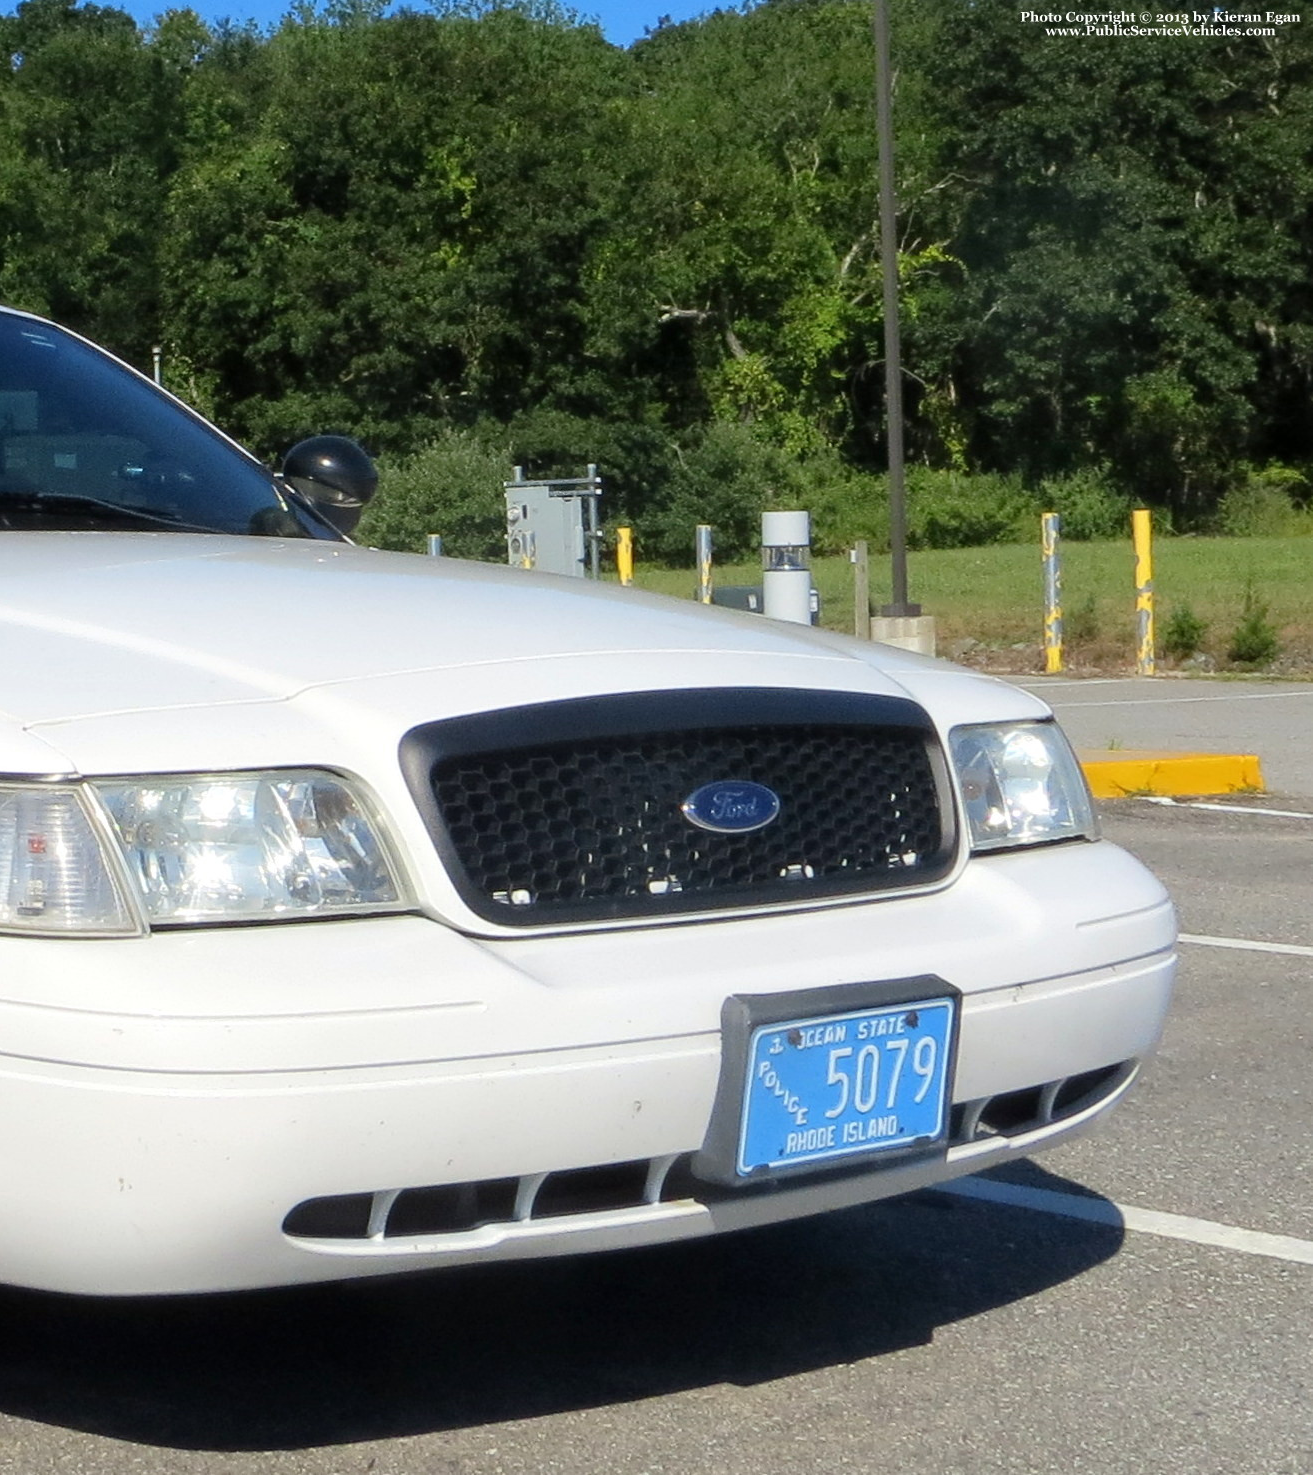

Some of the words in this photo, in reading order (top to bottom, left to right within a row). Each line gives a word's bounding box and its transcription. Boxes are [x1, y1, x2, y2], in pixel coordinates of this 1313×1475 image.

[712, 791, 758, 819] Ford
[858, 1015, 906, 1039] STATE
[758, 1060, 808, 1126] POLICE
[824, 1035, 937, 1119] 5079
[786, 1125, 836, 1154] RHODE
[843, 1116, 898, 1143] ISLAND
